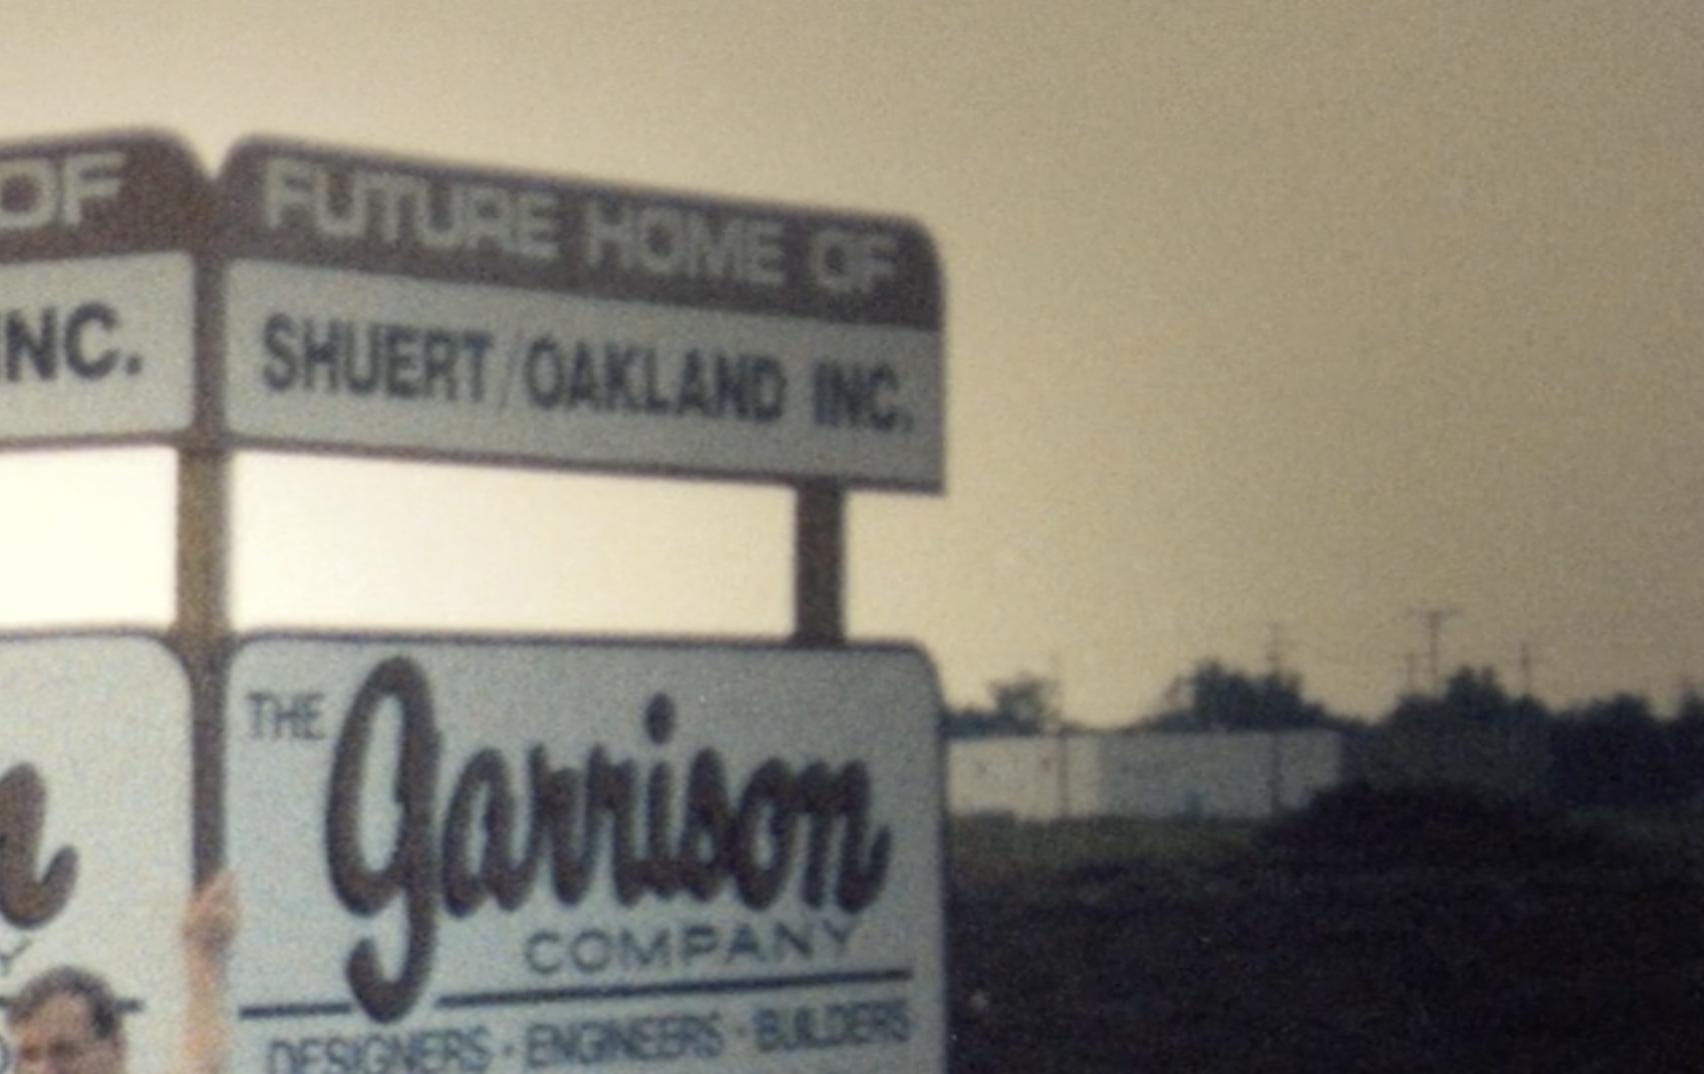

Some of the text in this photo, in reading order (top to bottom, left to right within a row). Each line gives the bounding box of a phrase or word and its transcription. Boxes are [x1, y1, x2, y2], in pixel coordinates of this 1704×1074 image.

[262, 157, 896, 294] FUTURE HOME OF
[811, 356, 913, 433] INC.
[245, 690, 327, 740] THE
[523, 920, 863, 974] COMPANY
[525, 1012, 724, 1070] ENGINEERS
[754, 1001, 910, 1050] BUILDERS
